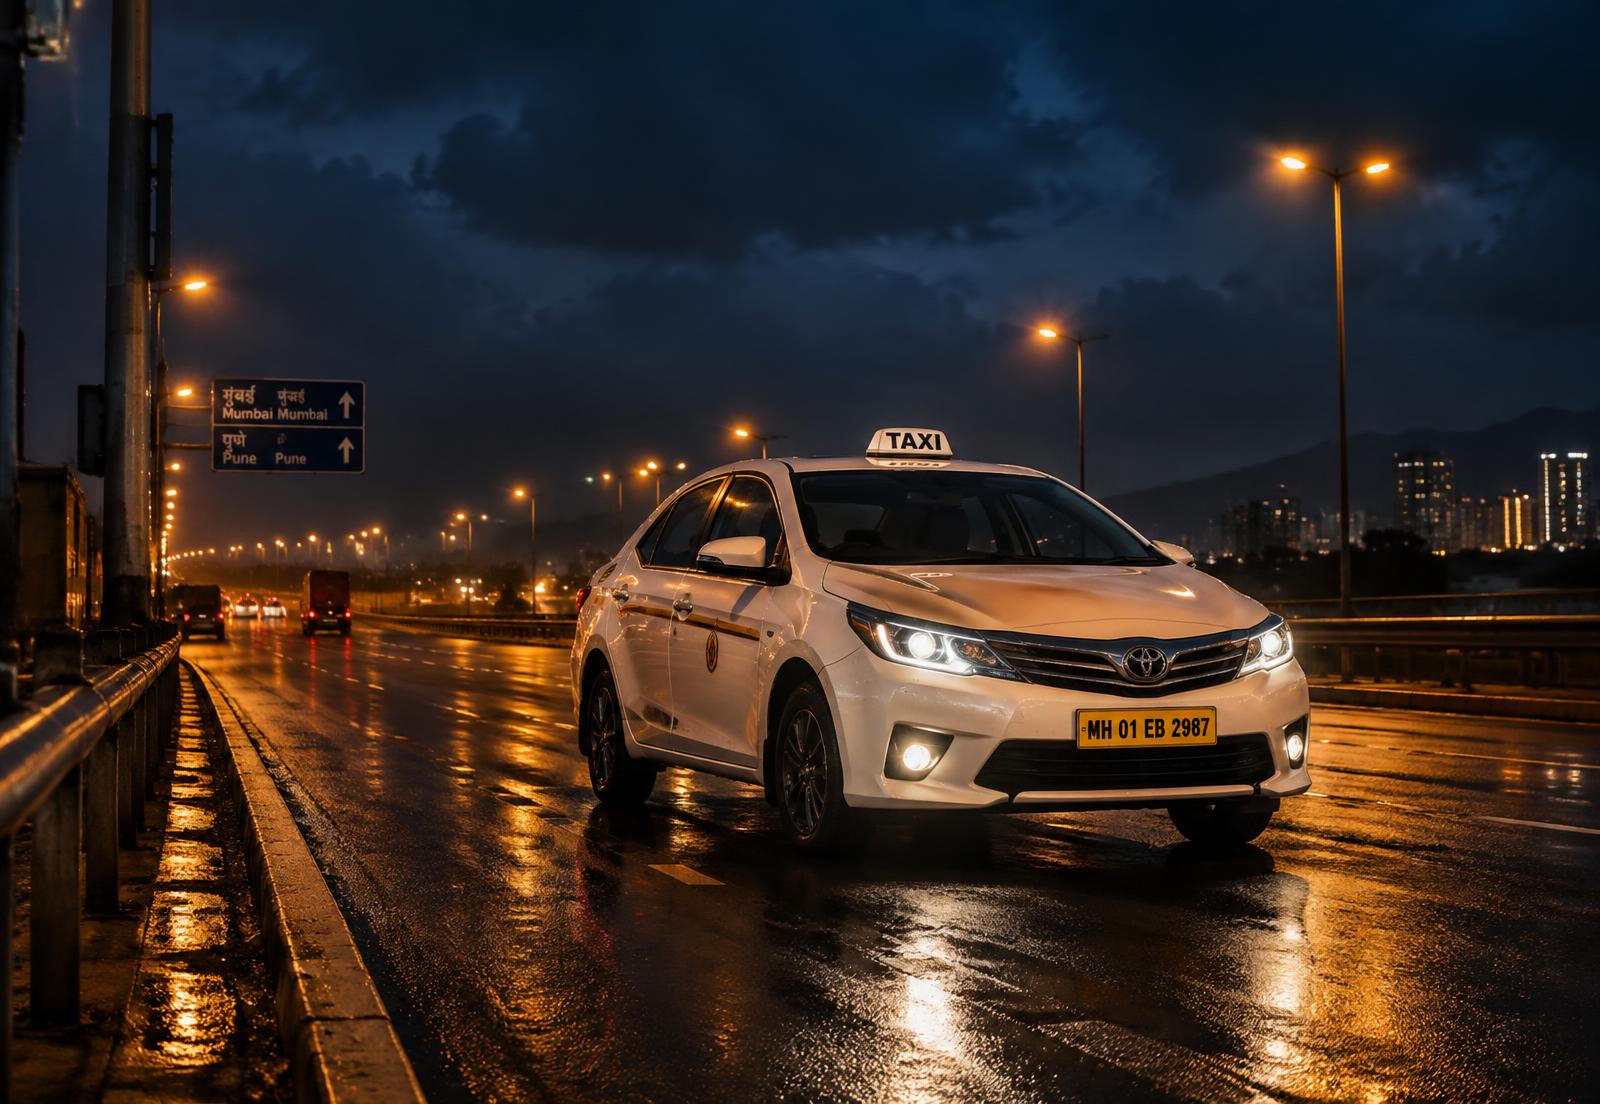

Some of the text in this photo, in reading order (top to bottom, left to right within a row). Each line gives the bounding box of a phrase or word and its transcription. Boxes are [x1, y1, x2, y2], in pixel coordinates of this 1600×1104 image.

[222, 407, 328, 421] Mumbai Mumbai
[885, 432, 942, 451] TAXI
[222, 452, 307, 465] Pune Pune
[1087, 717, 1210, 740] MH 01 EB 2987
